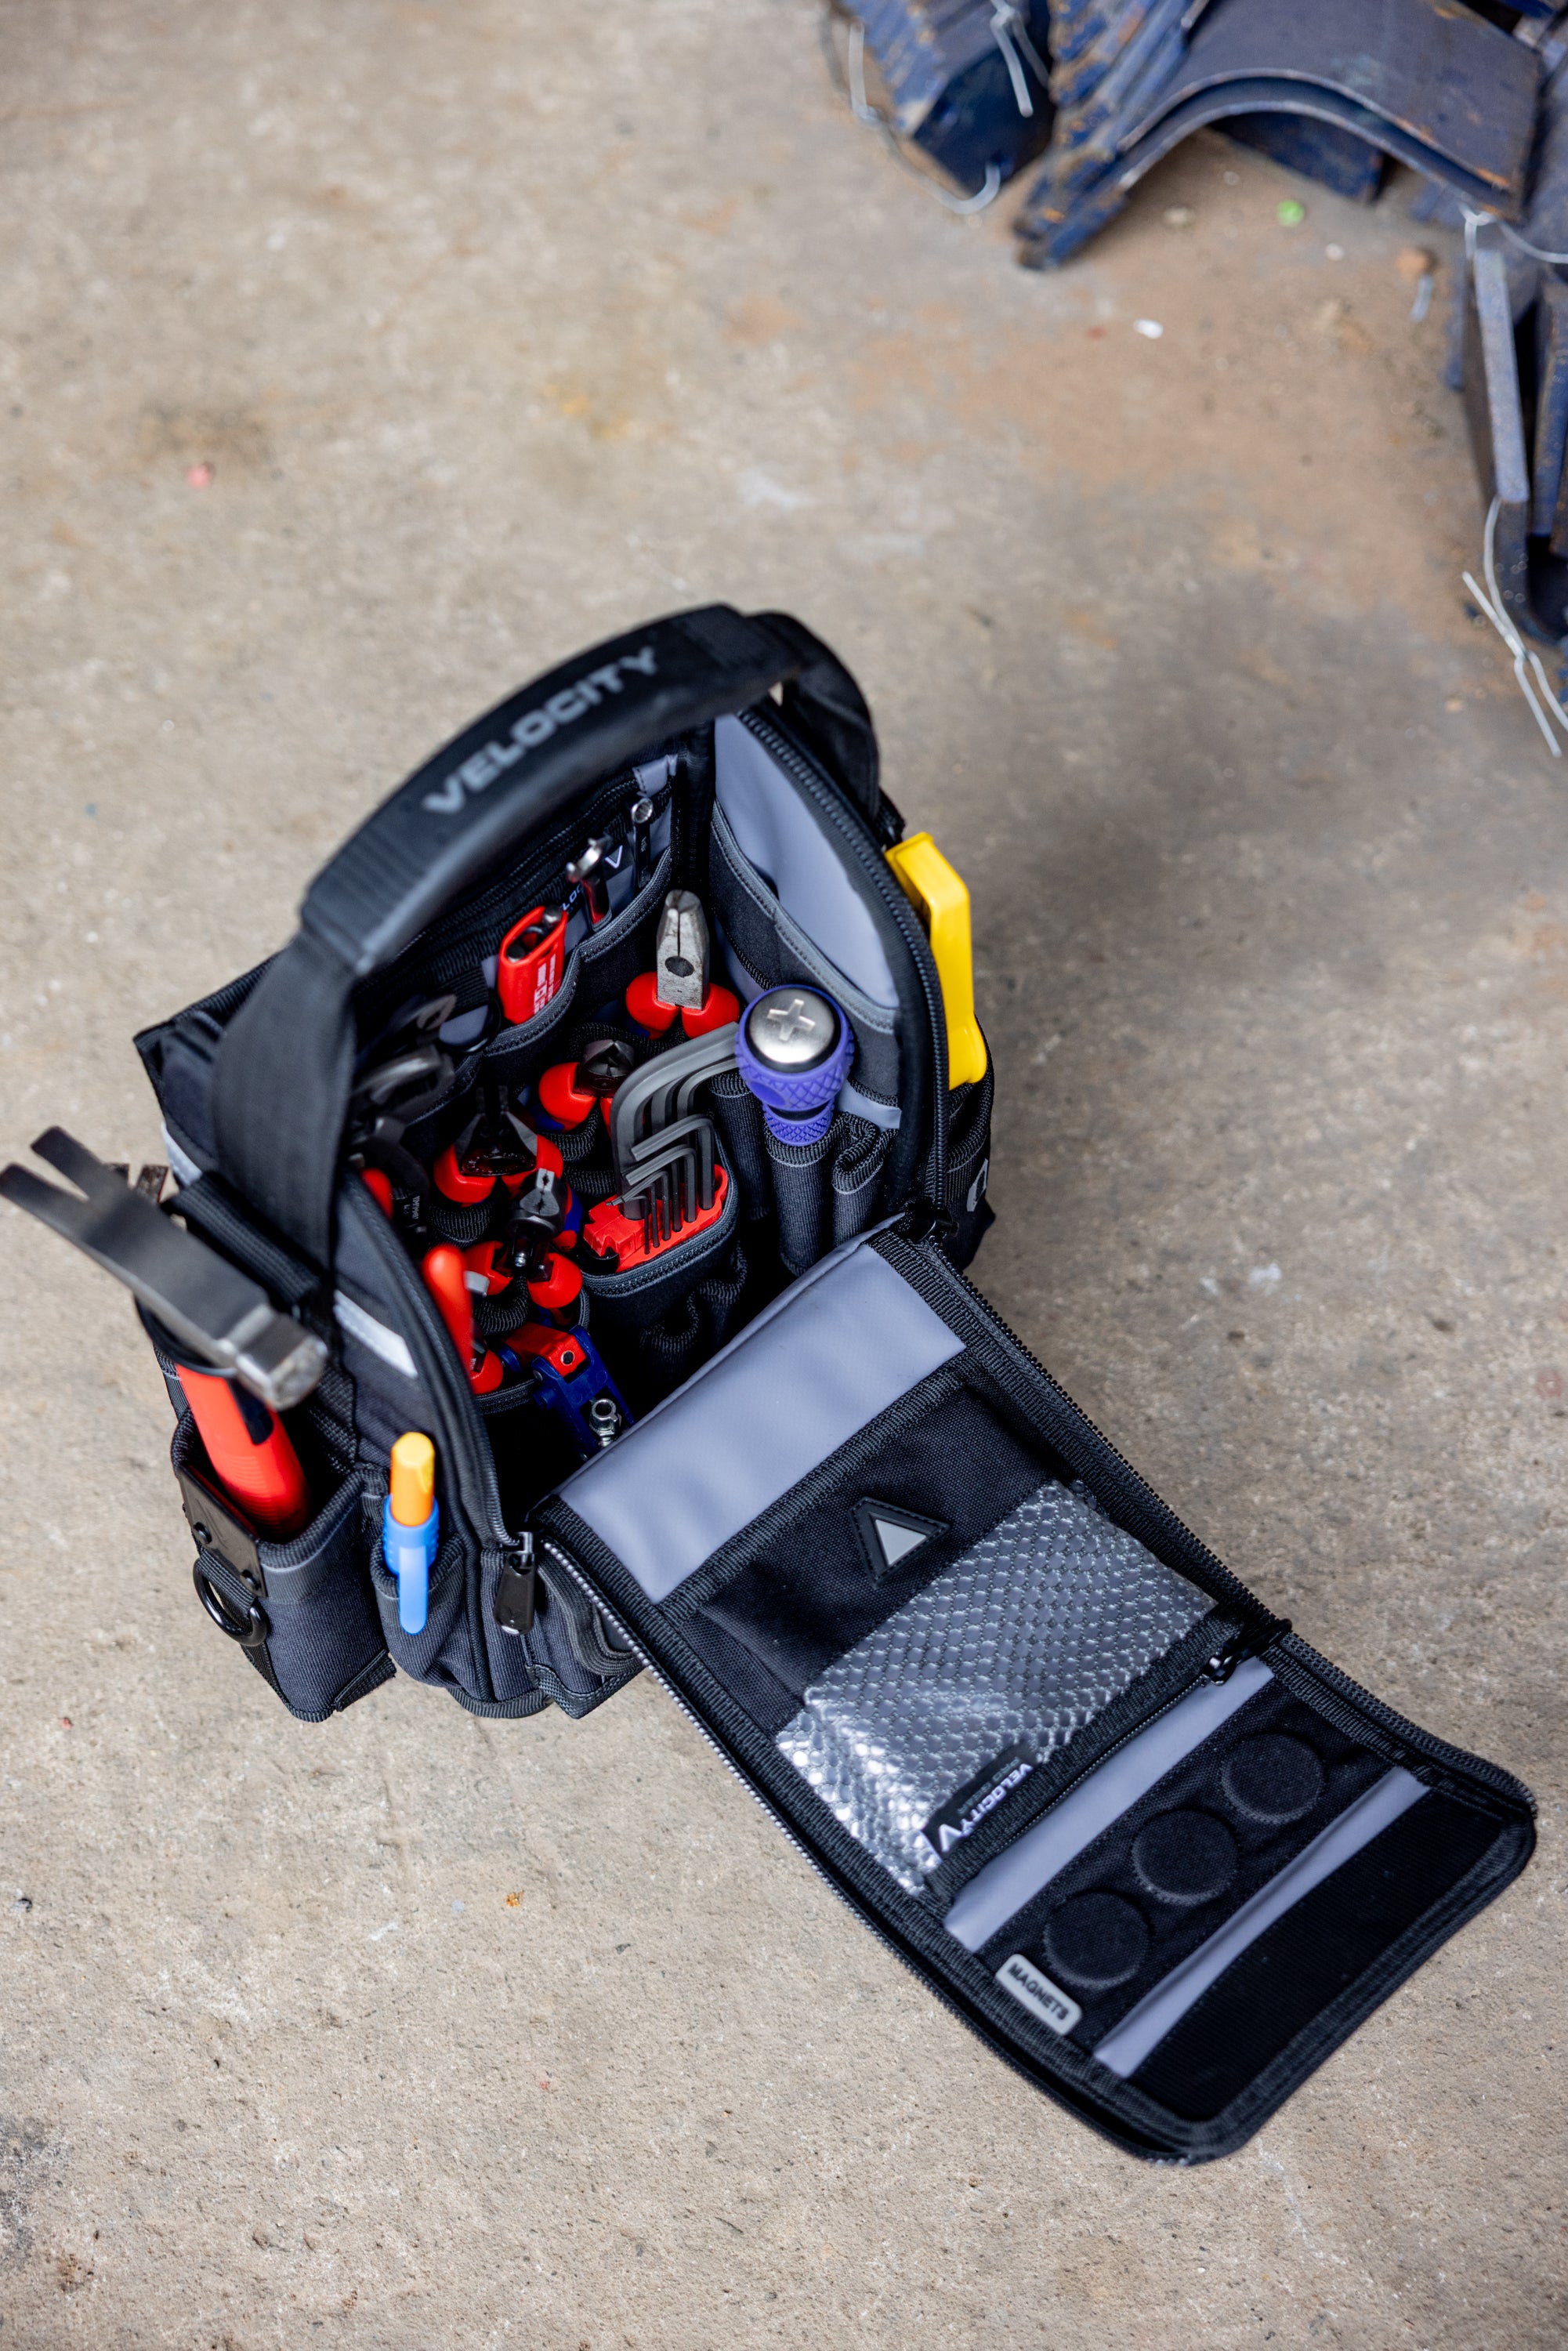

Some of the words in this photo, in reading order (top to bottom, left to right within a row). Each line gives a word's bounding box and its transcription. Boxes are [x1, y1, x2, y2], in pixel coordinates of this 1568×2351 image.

[422, 646, 657, 813] VELOCITY
[960, 1763, 1033, 1836] VELOCITY
[992, 1757, 1020, 1782] PRO
[1008, 1962, 1070, 2020] MAGNETS
